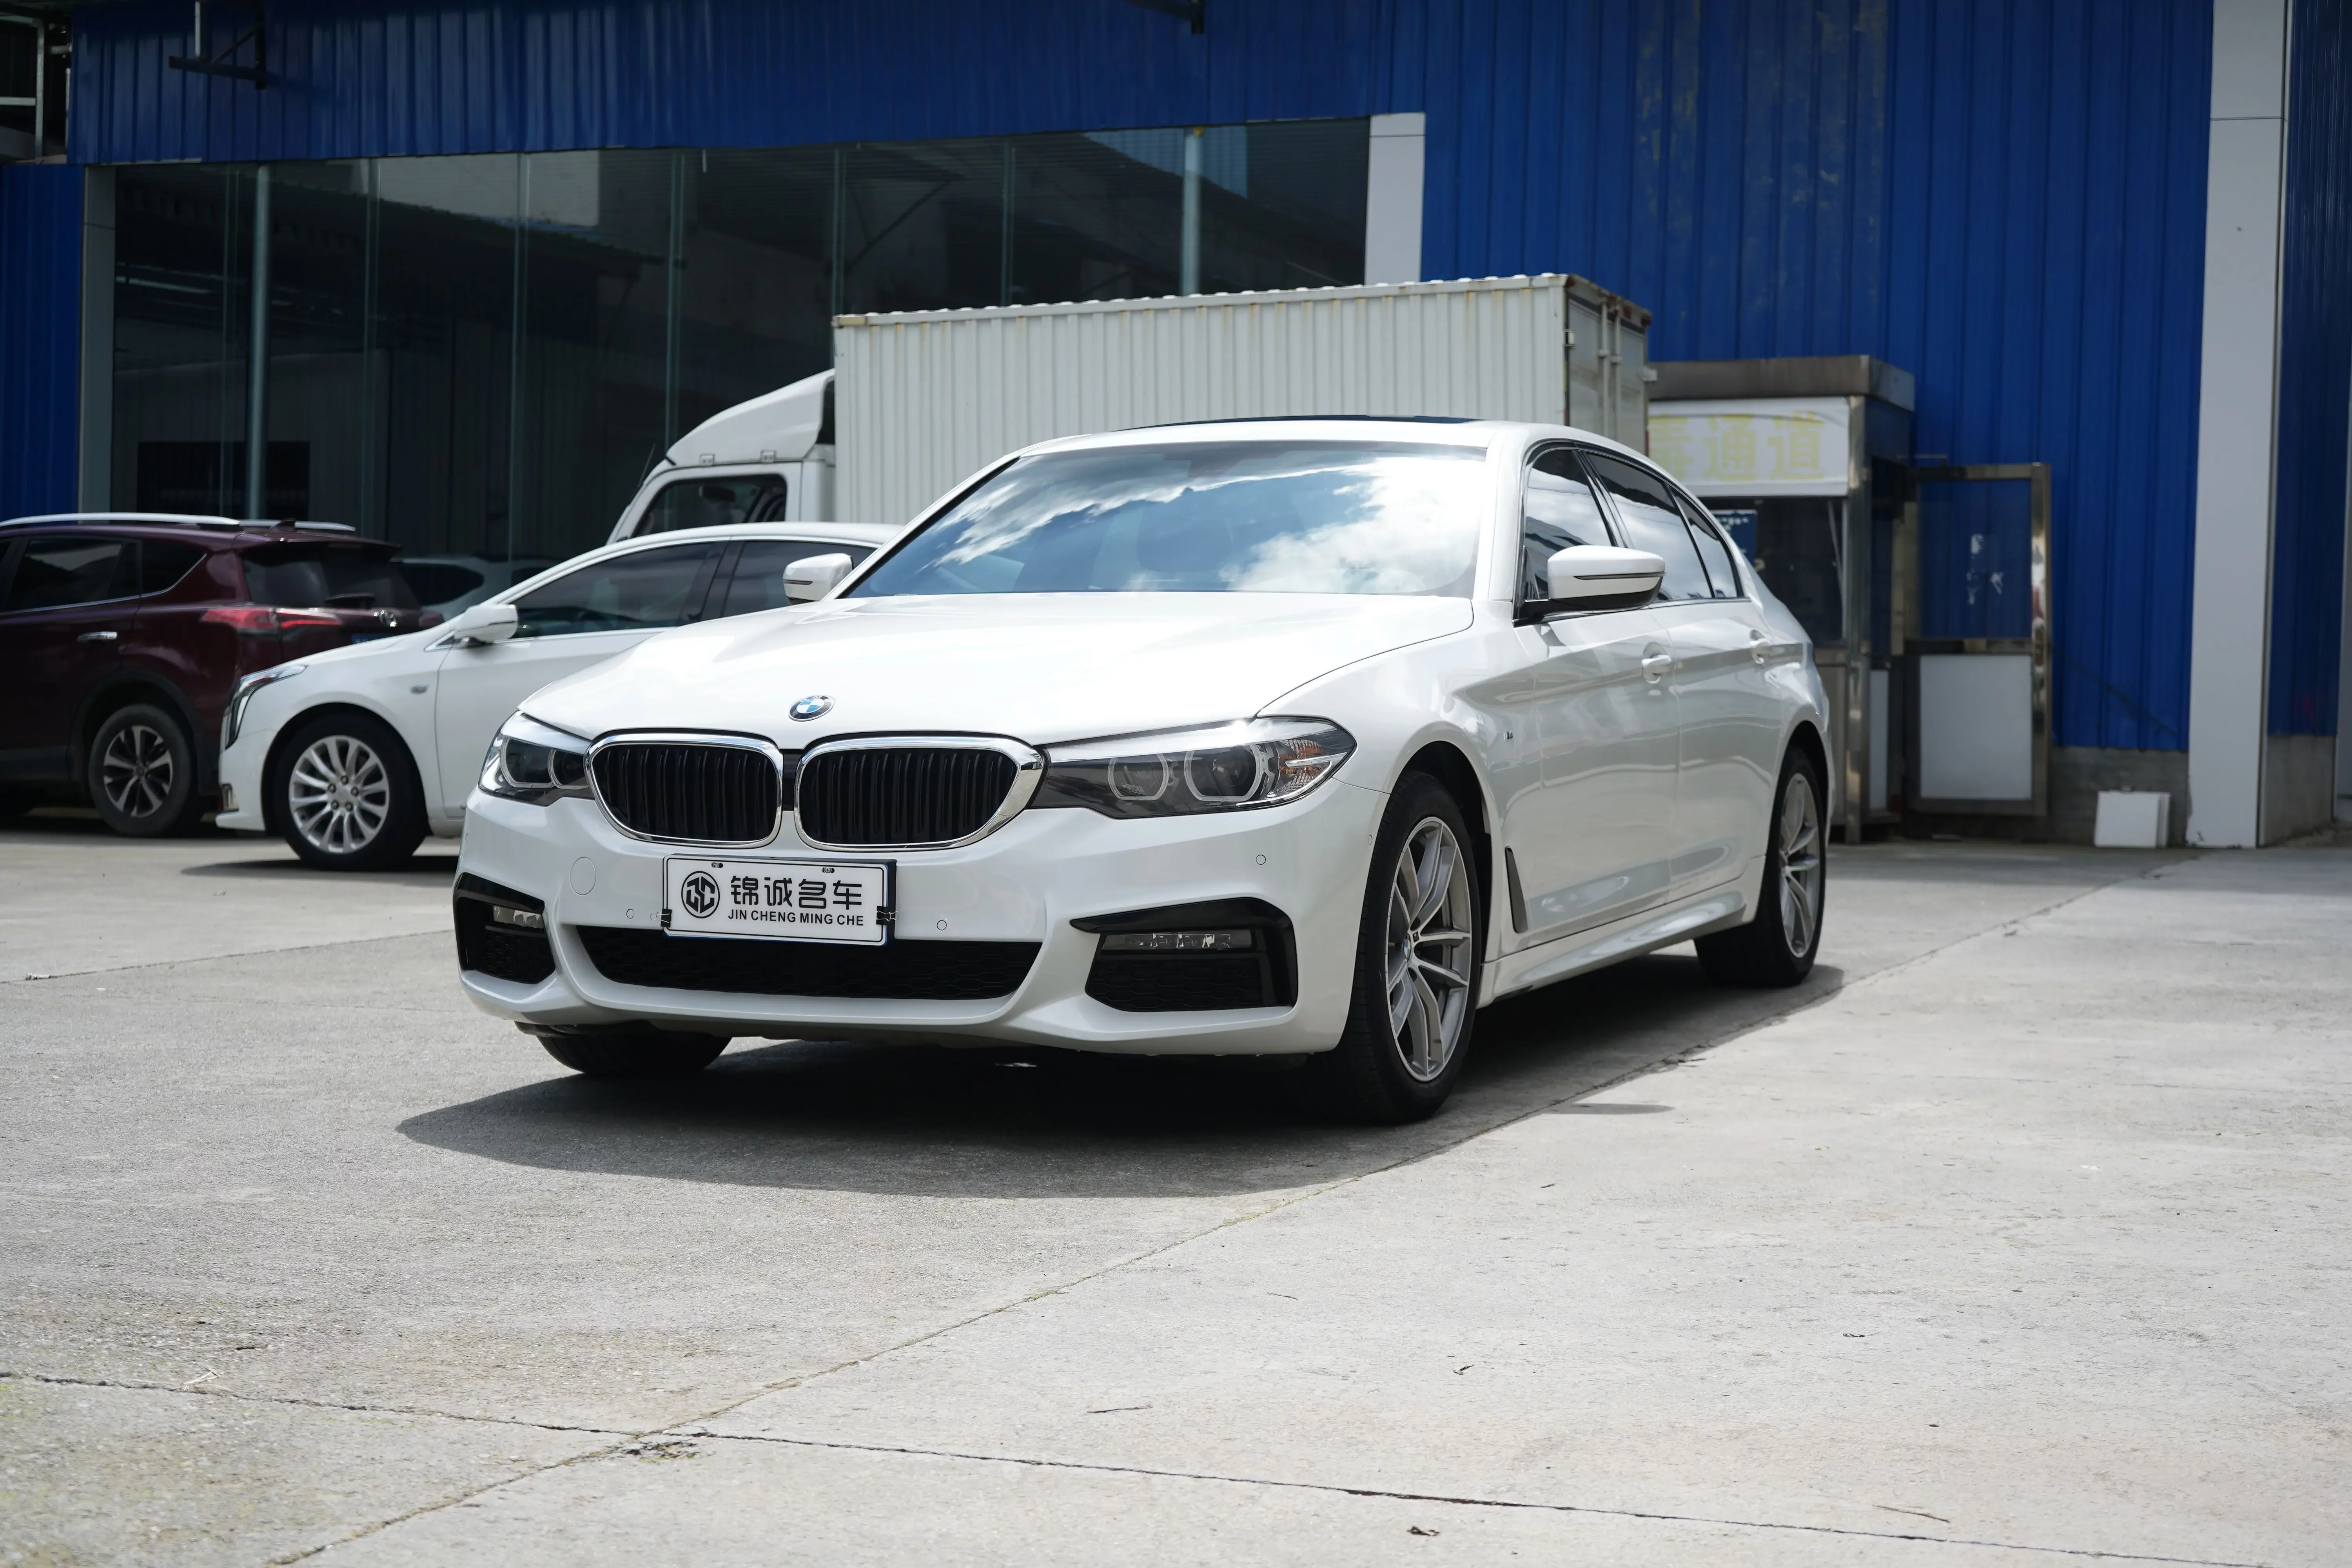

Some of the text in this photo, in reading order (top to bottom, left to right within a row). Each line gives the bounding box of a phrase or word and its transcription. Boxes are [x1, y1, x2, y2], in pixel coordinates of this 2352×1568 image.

[731, 875, 862, 910] 锦诚名车
[728, 909, 864, 926] JIN CHENG MING CHE
